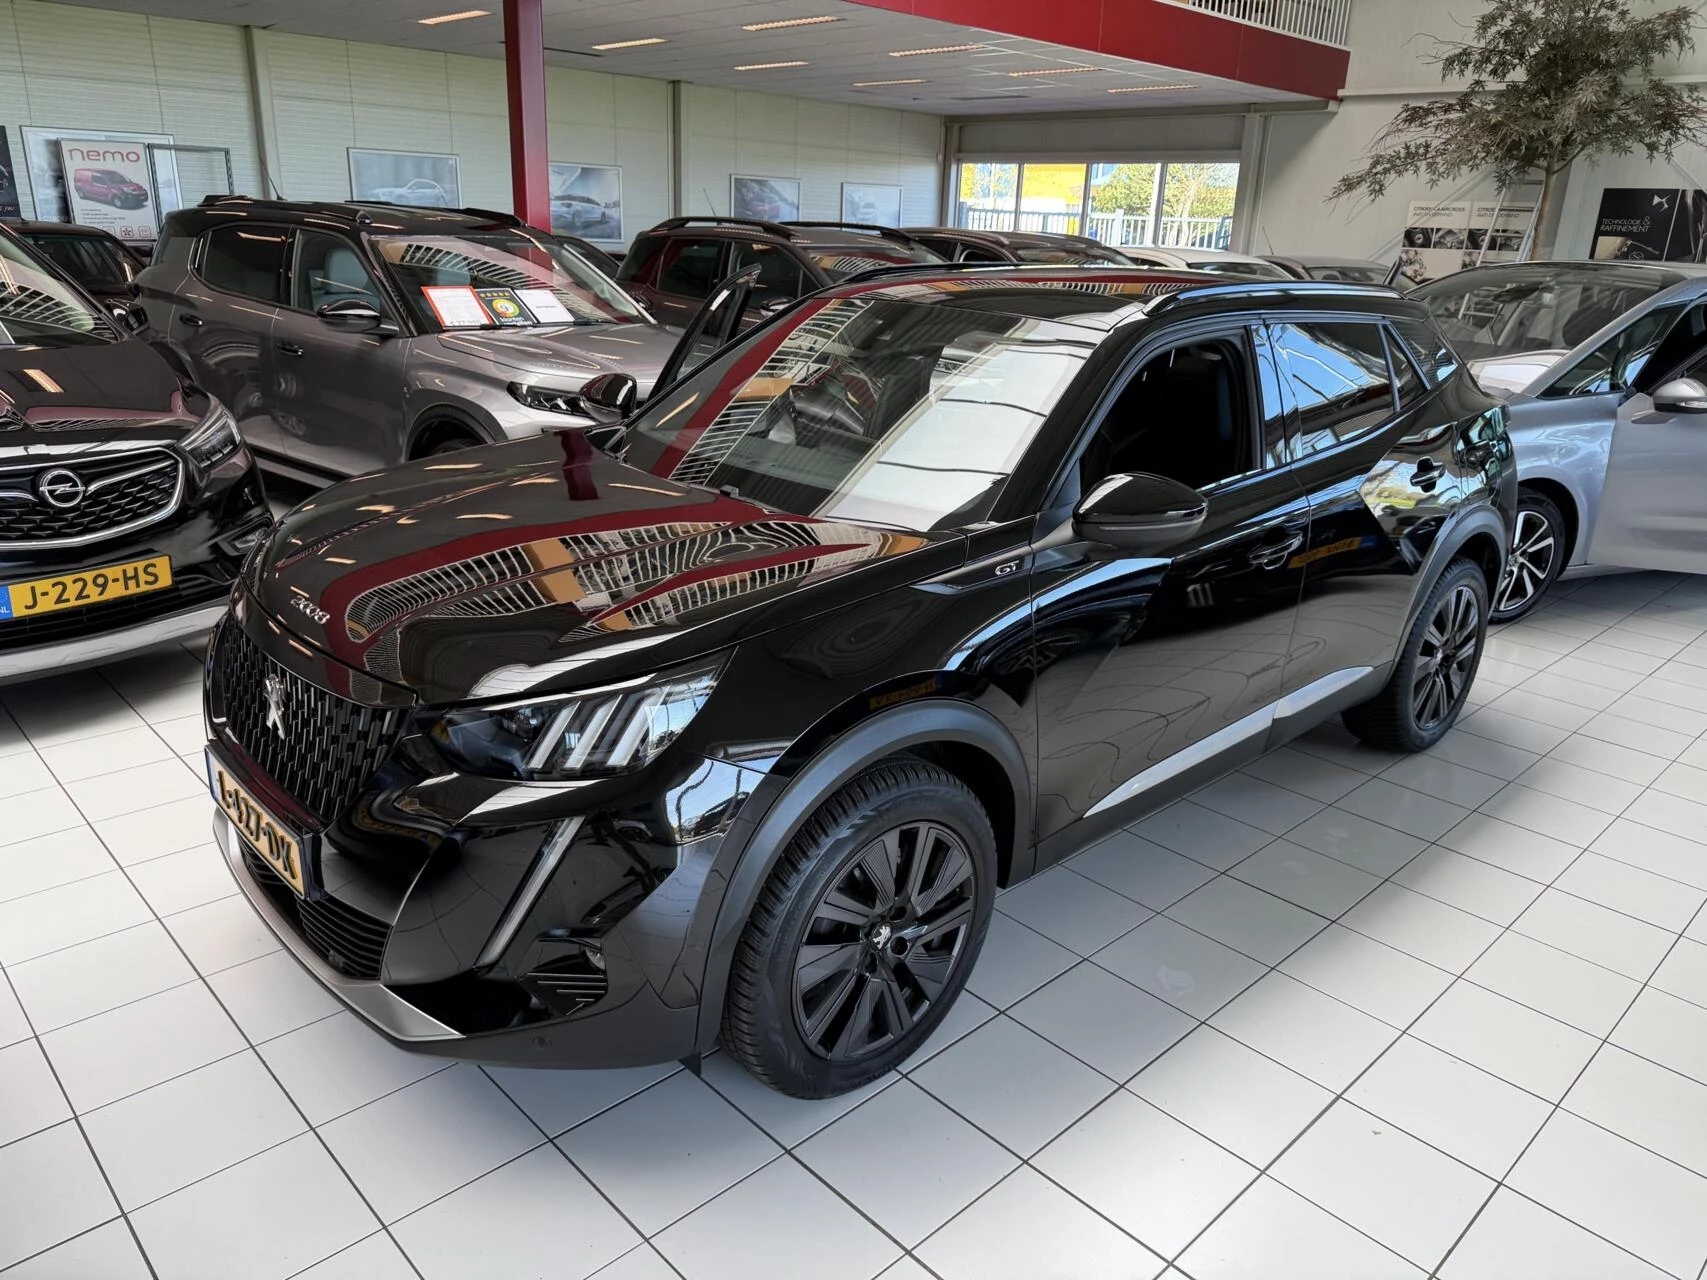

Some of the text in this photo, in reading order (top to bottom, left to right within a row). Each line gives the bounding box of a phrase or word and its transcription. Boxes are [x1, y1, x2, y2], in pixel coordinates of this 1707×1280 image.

[67, 147, 141, 163] nemo
[1642, 215, 1650, 225] &
[1600, 224, 1650, 233] RAFFINEMENT
[994, 560, 1020, 576] GT
[24, 562, 160, 611] J-229-HS
